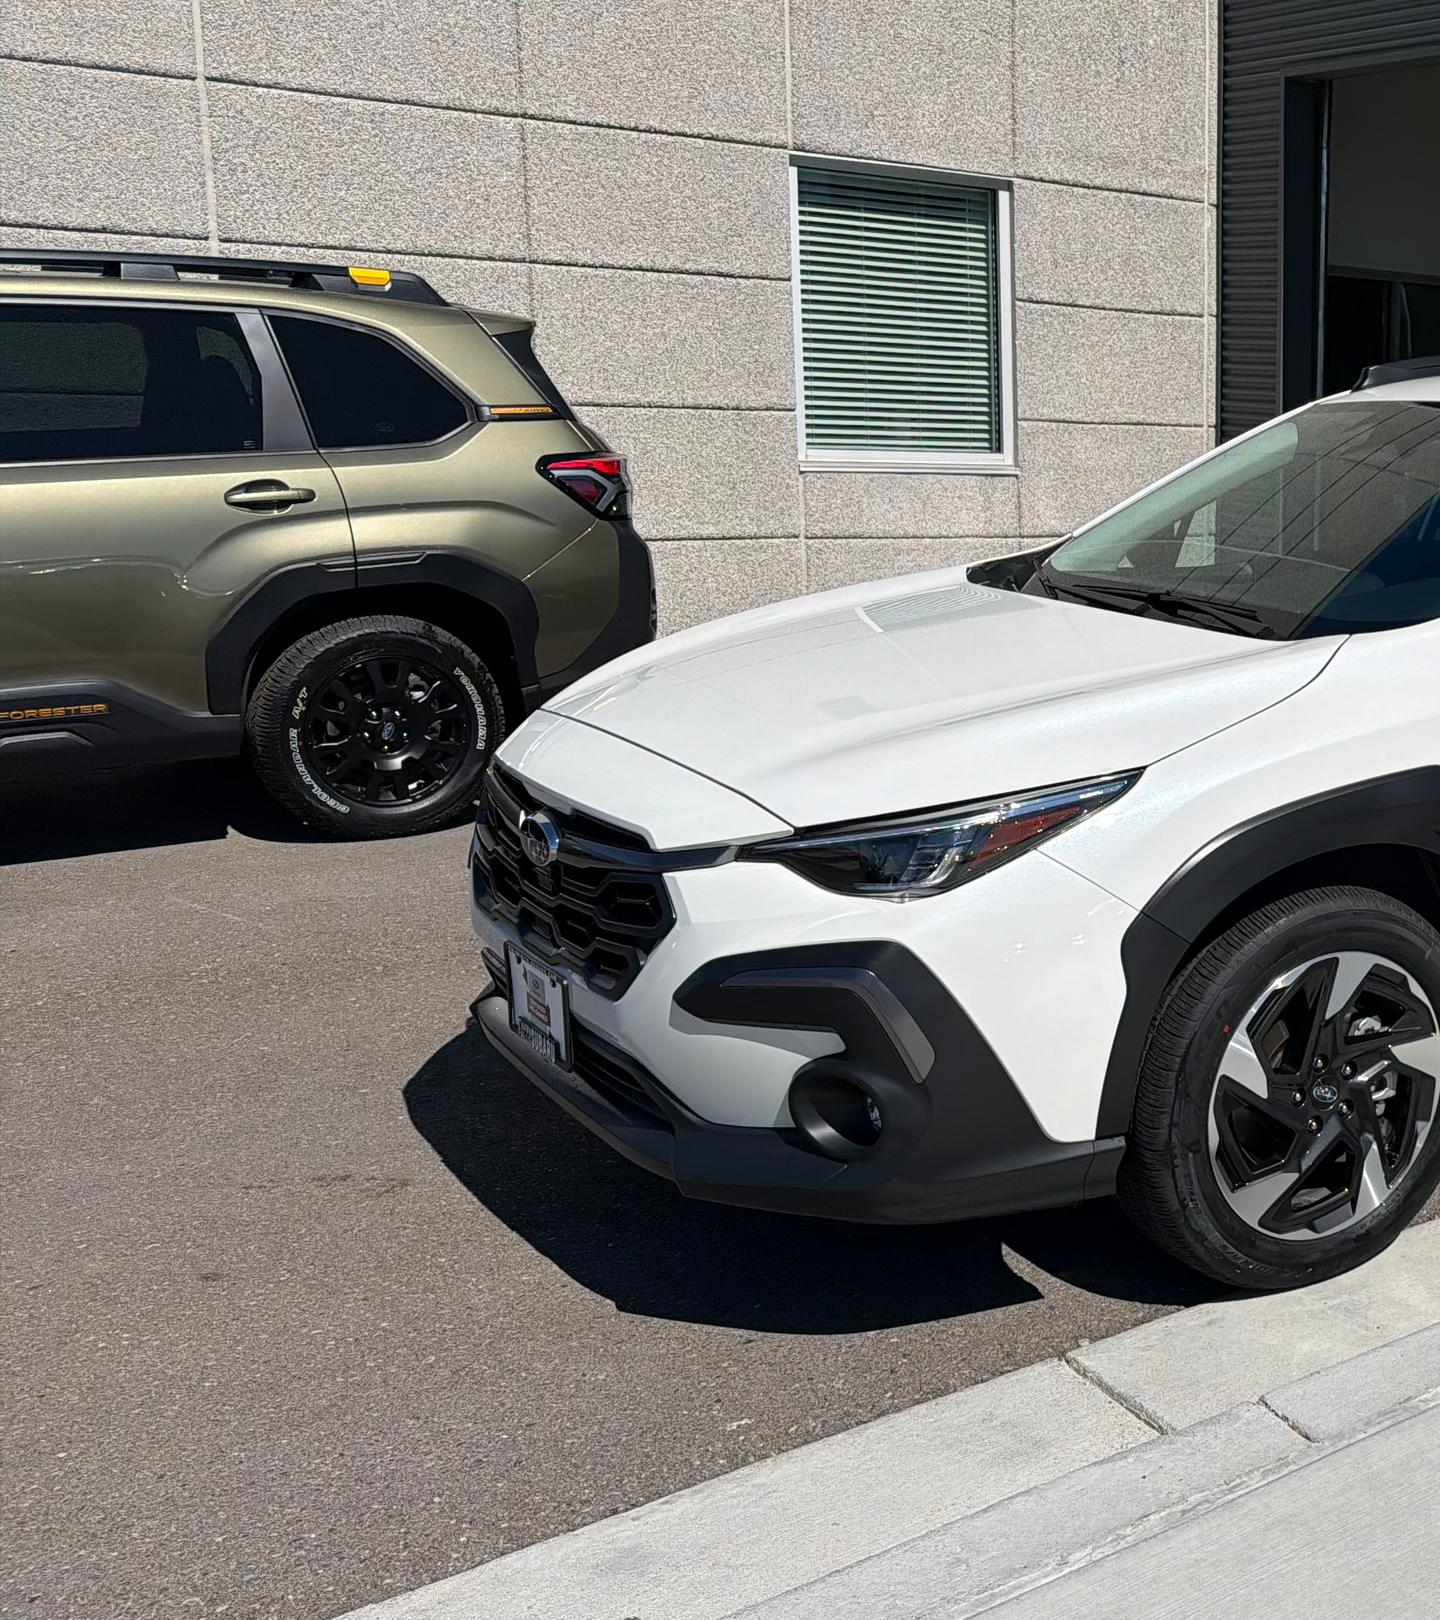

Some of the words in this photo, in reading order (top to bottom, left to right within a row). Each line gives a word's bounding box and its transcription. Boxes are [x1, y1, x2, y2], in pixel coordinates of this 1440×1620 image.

[0, 703, 107, 720] FORESTER
[292, 686, 308, 719] A/T
[453, 667, 487, 750] YOKOHAMA
[289, 727, 350, 814] GEOLANDAR
